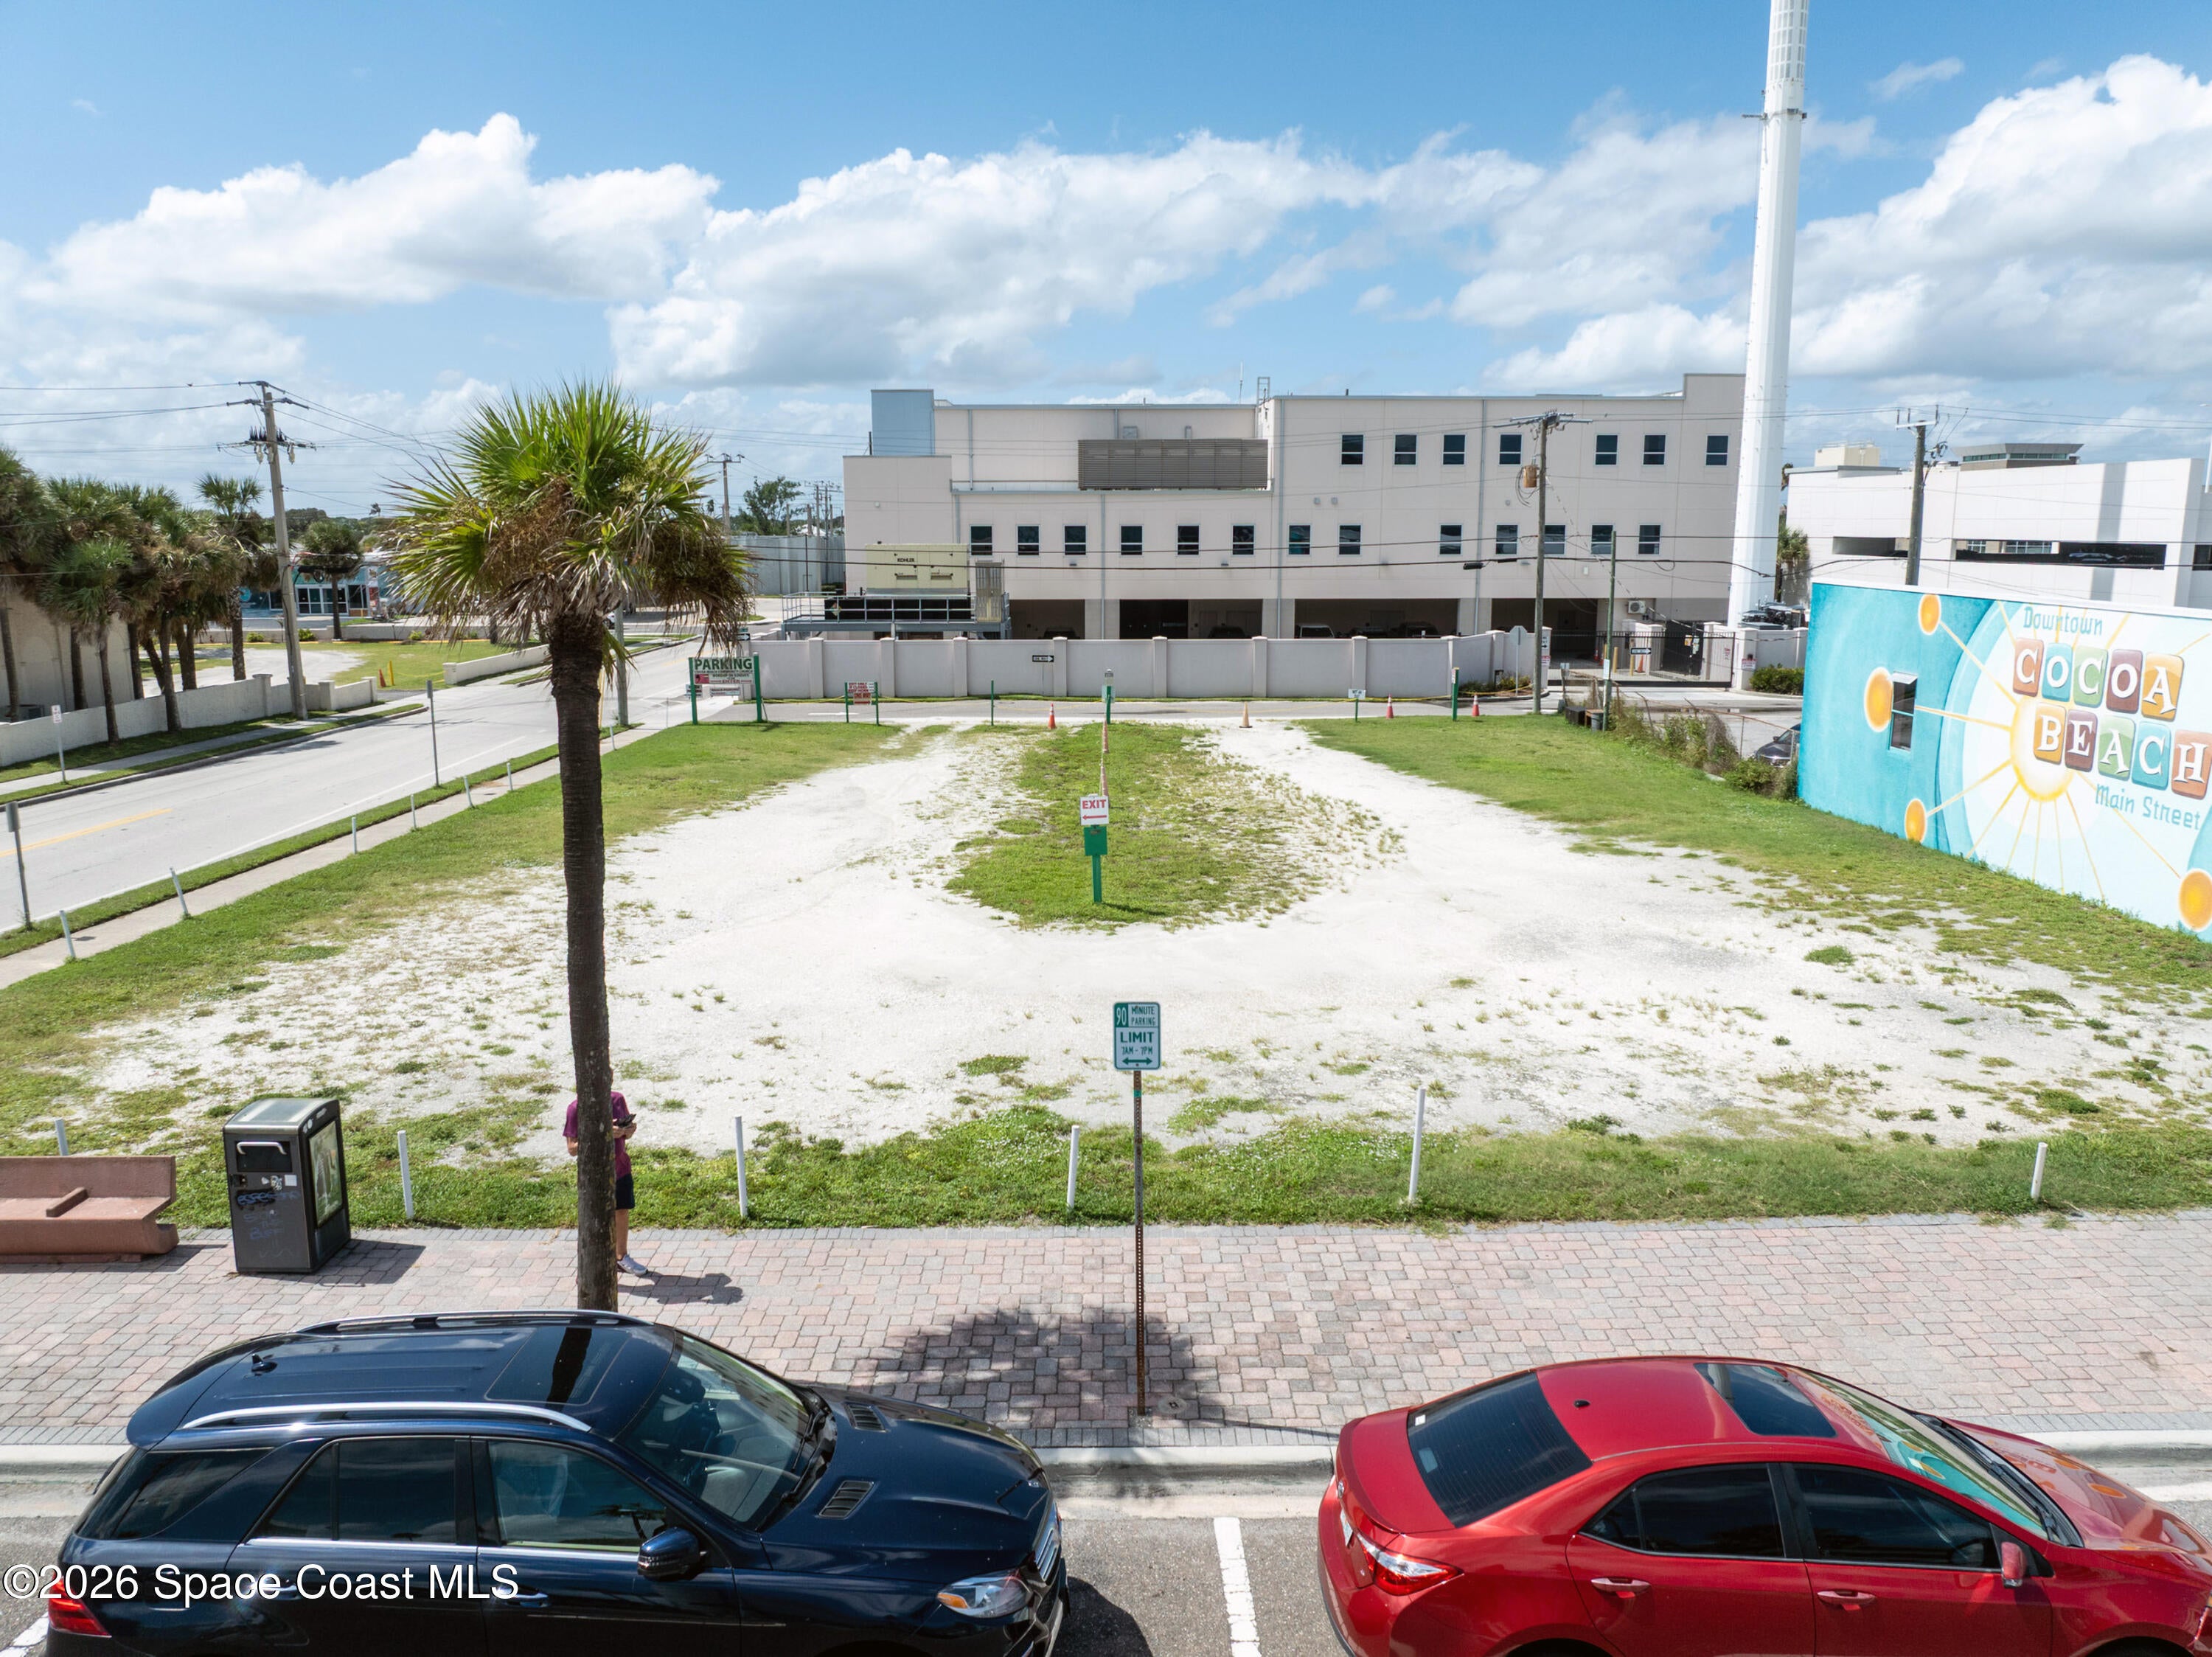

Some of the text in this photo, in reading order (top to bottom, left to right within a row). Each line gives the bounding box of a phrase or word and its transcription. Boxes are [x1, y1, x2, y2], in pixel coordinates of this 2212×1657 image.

[2023, 605, 2103, 636] Downtown
[695, 658, 752, 670] PARKING
[2016, 647, 2177, 715] COCOA
[2037, 714, 2209, 784] BEACH
[1082, 799, 1107, 809] EXIT
[2095, 783, 2201, 830] Main Street
[1116, 1007, 1127, 1026] 90
[1131, 1005, 1155, 1015] MINUTE
[1131, 1017, 1156, 1026] PARKING
[1120, 1032, 1155, 1043] LIMIT
